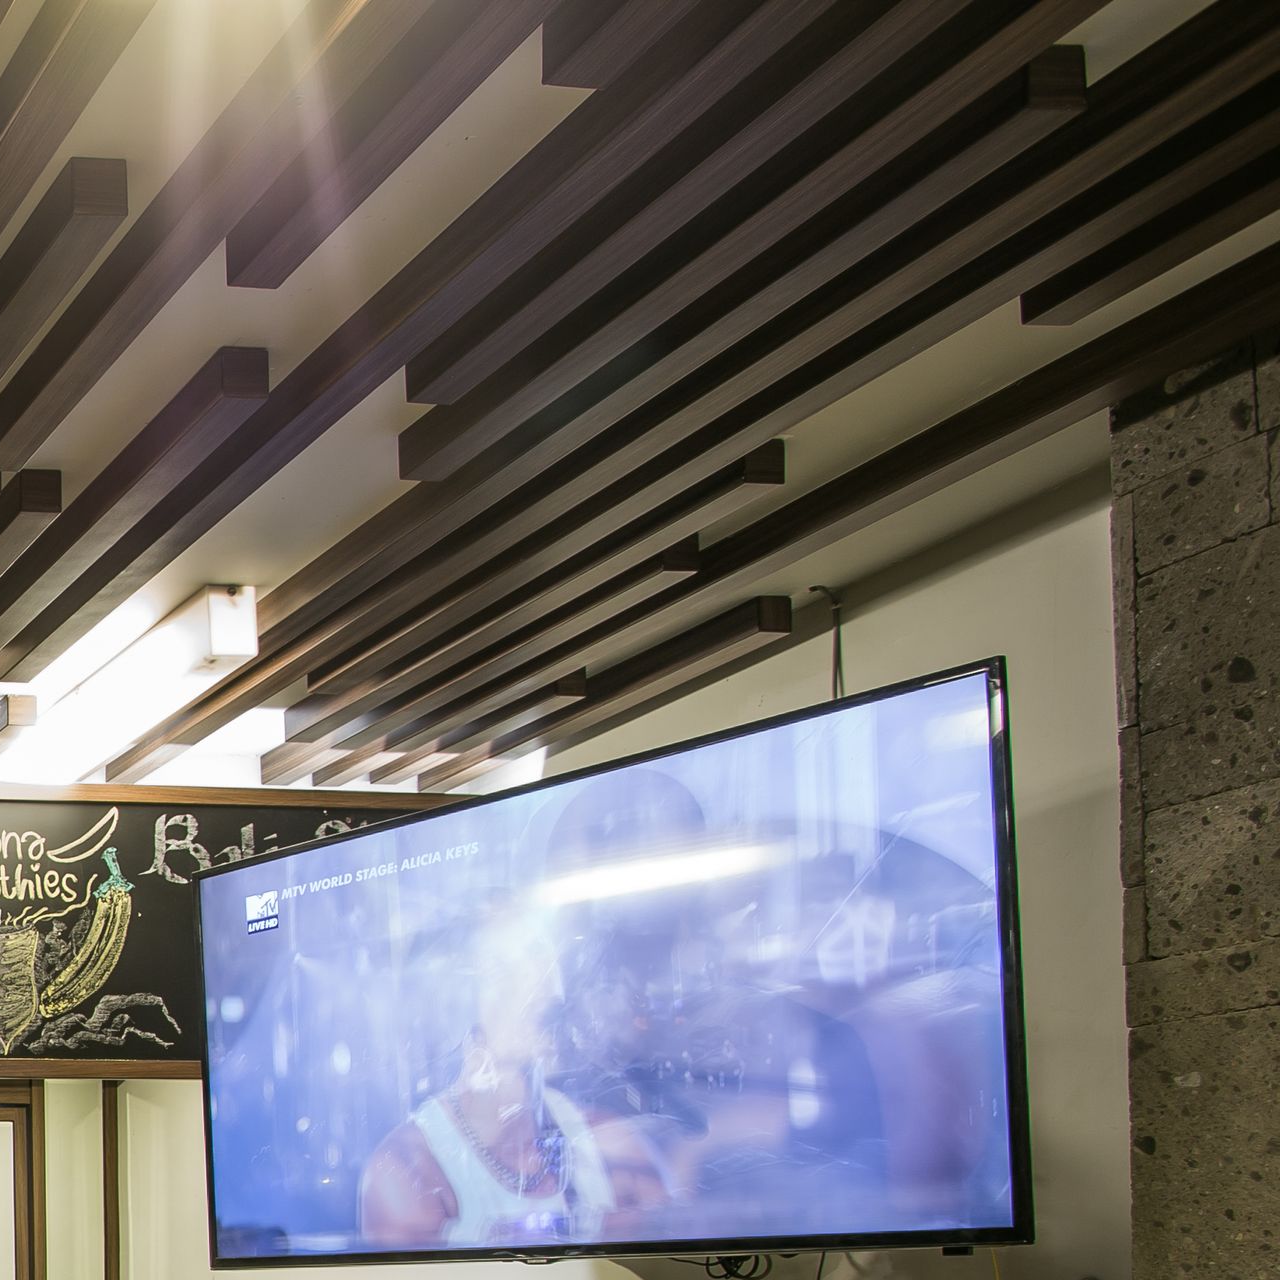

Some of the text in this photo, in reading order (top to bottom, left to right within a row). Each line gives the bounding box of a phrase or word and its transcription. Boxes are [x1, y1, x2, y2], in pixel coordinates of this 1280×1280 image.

[281, 841, 480, 901] MTV WORLD STAGE: ALICIA KEYS
